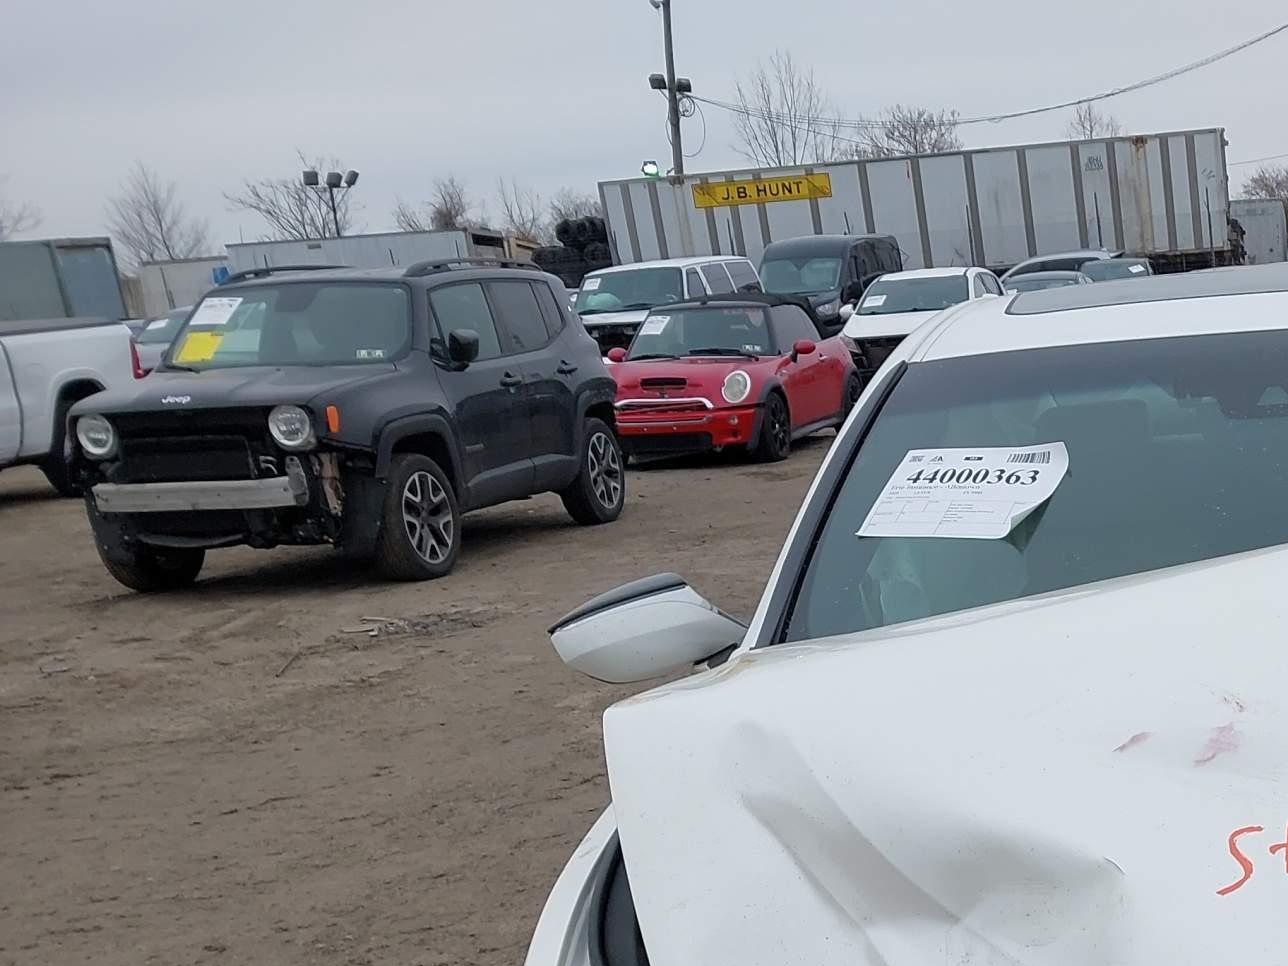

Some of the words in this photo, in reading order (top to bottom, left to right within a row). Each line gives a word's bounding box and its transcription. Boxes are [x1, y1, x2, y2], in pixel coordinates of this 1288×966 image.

[721, 186, 753, 200] J.B.
[756, 181, 803, 198] HUNT
[161, 395, 191, 404] Jeep
[907, 468, 1040, 485] 44000363
